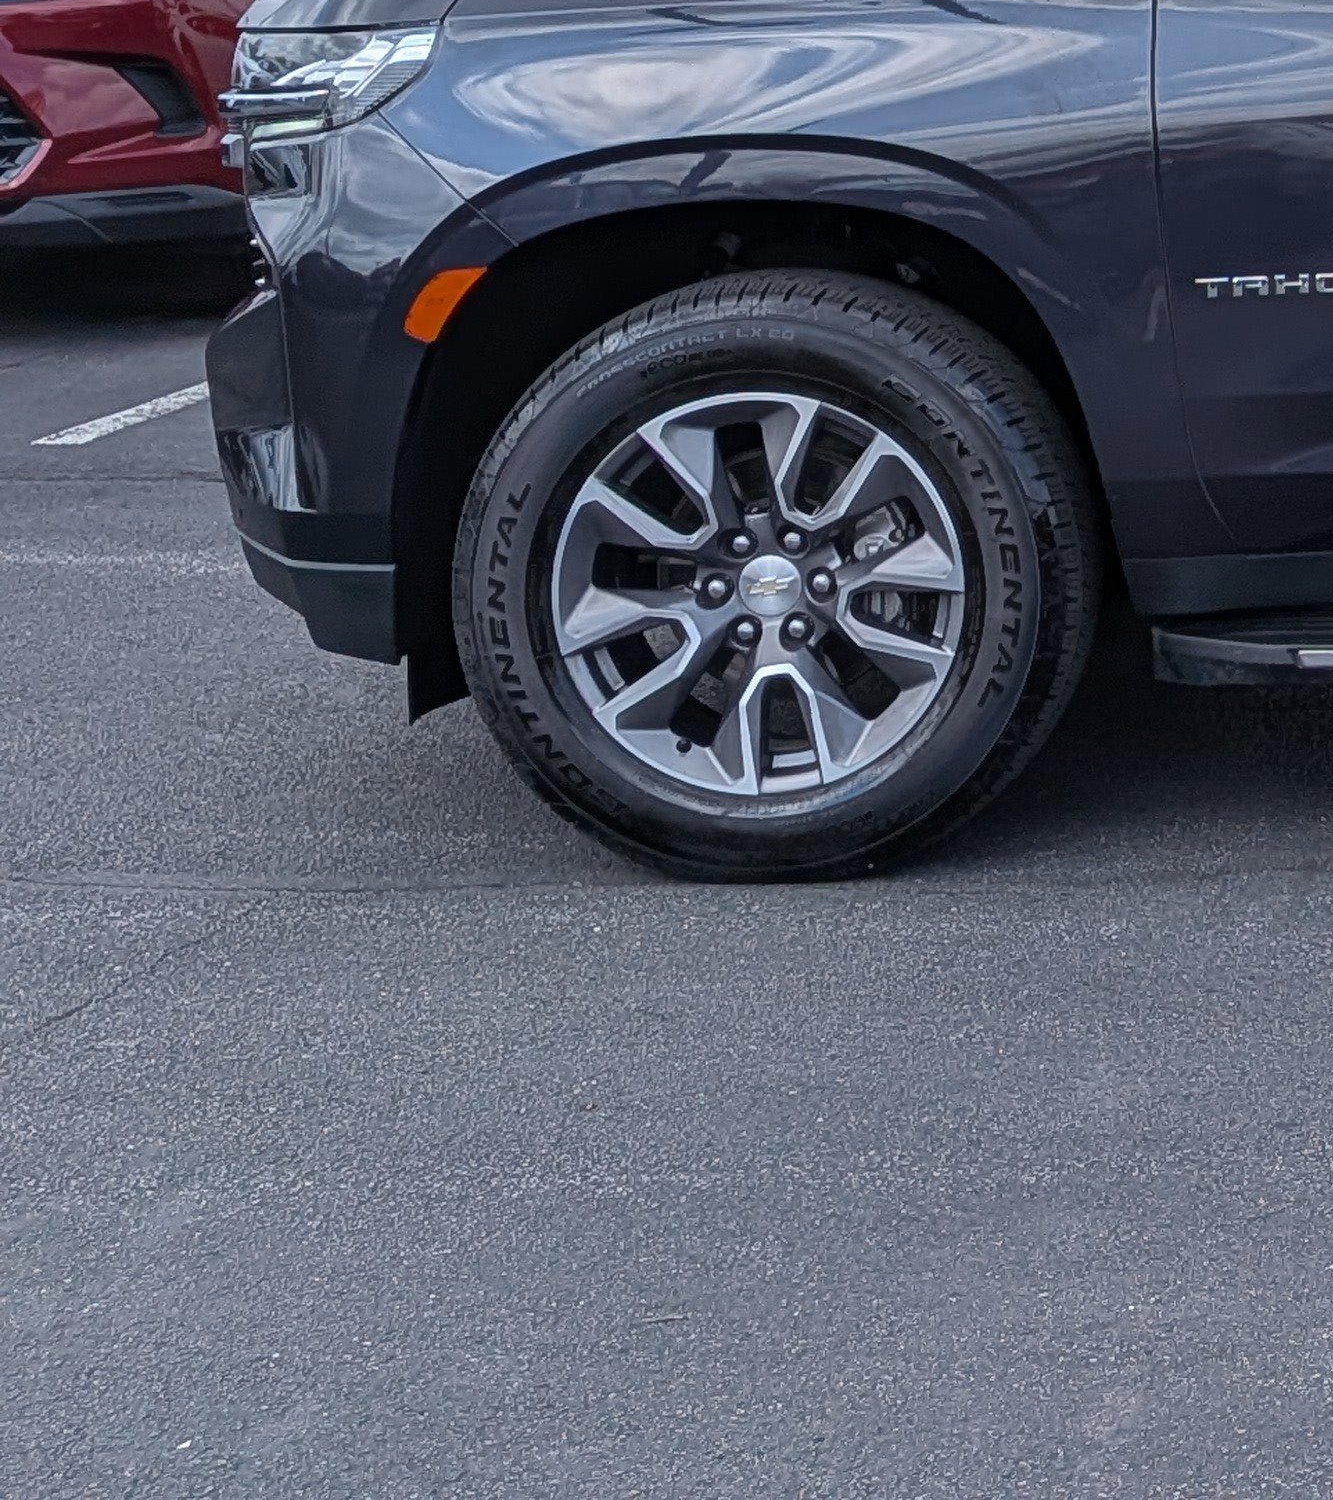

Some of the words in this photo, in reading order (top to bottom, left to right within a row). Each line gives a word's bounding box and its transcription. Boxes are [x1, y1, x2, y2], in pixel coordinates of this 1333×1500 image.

[736, 327, 761, 339] LX
[486, 482, 631, 816] CONTINENTAL
[882, 373, 1023, 708] CONTINENTAL
